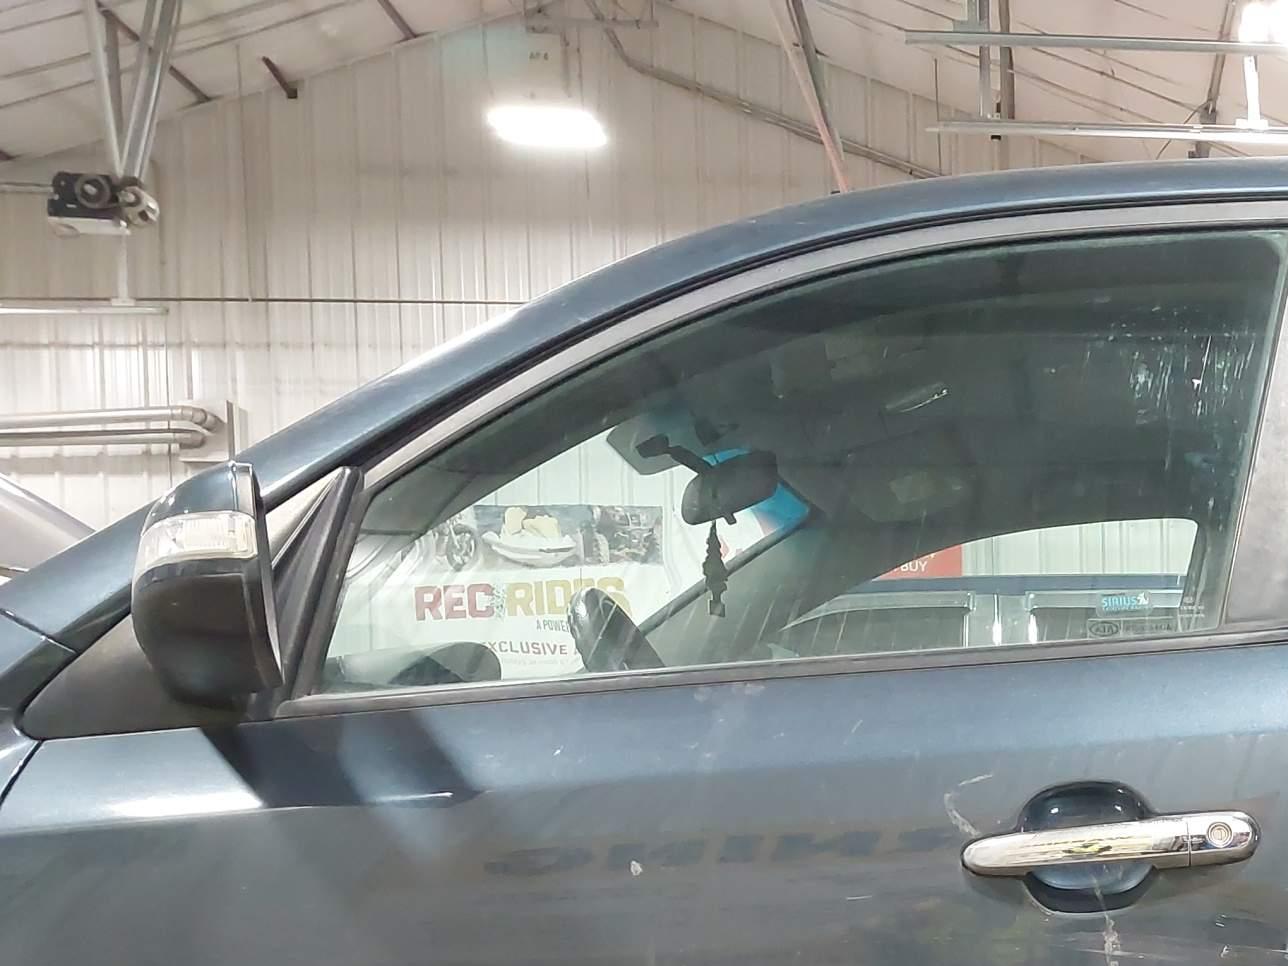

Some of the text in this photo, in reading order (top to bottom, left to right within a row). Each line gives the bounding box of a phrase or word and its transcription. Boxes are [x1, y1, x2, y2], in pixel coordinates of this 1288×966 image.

[900, 560, 928, 572] BUY
[414, 577, 633, 620] REC RIDS
[1102, 596, 1137, 609] SIRIUS
[483, 640, 568, 655] XCLUSIVE
